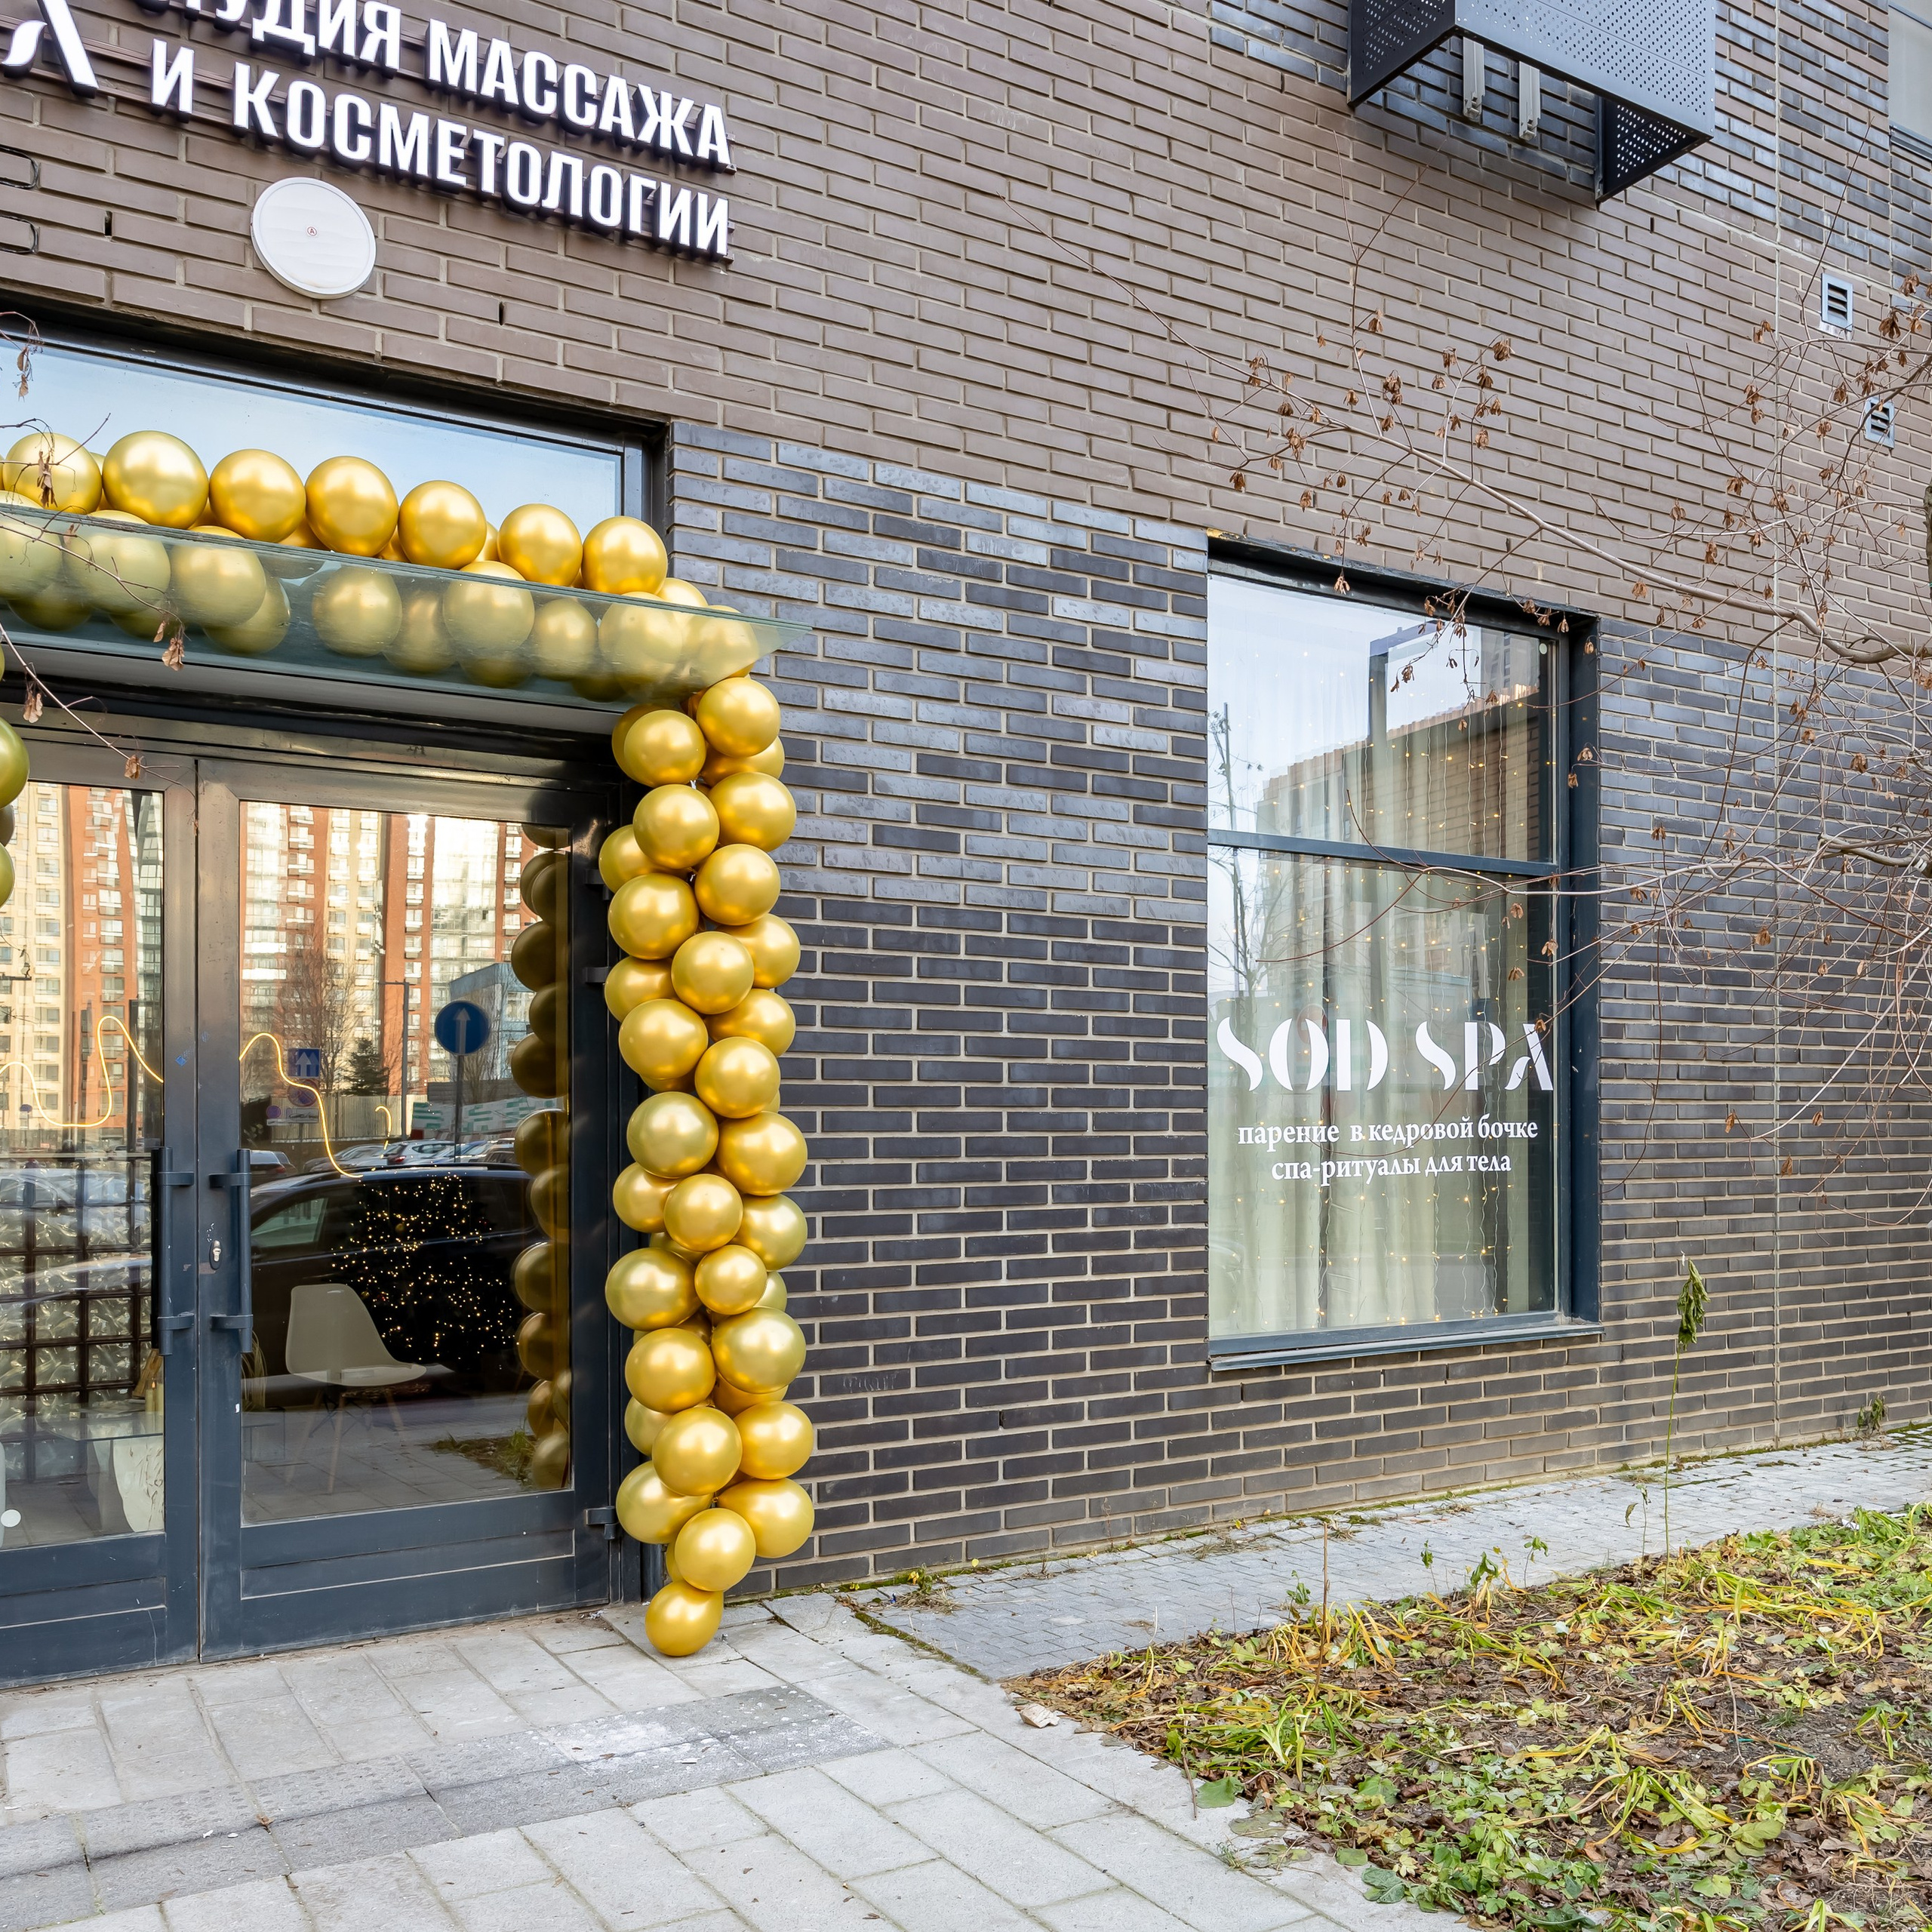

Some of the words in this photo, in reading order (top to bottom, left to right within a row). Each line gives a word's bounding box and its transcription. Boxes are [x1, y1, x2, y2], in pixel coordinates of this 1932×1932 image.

[428, 18, 732, 165] МАССАЖА
[151, 38, 195, 114] И
[233, 61, 729, 256] КОСМЕТОЛОГИИ
[1216, 1016, 1389, 1092] SOD
[1414, 1020, 1554, 1091] SPA
[1237, 1122, 1340, 1152] парение
[1350, 1123, 1364, 1141] в
[1368, 1115, 1474, 1149] кедровой
[1477, 1112, 1539, 1140] бочке
[1271, 1155, 1420, 1187] спа-ритуалы
[1425, 1154, 1463, 1178] для
[1466, 1154, 1512, 1173] тела
